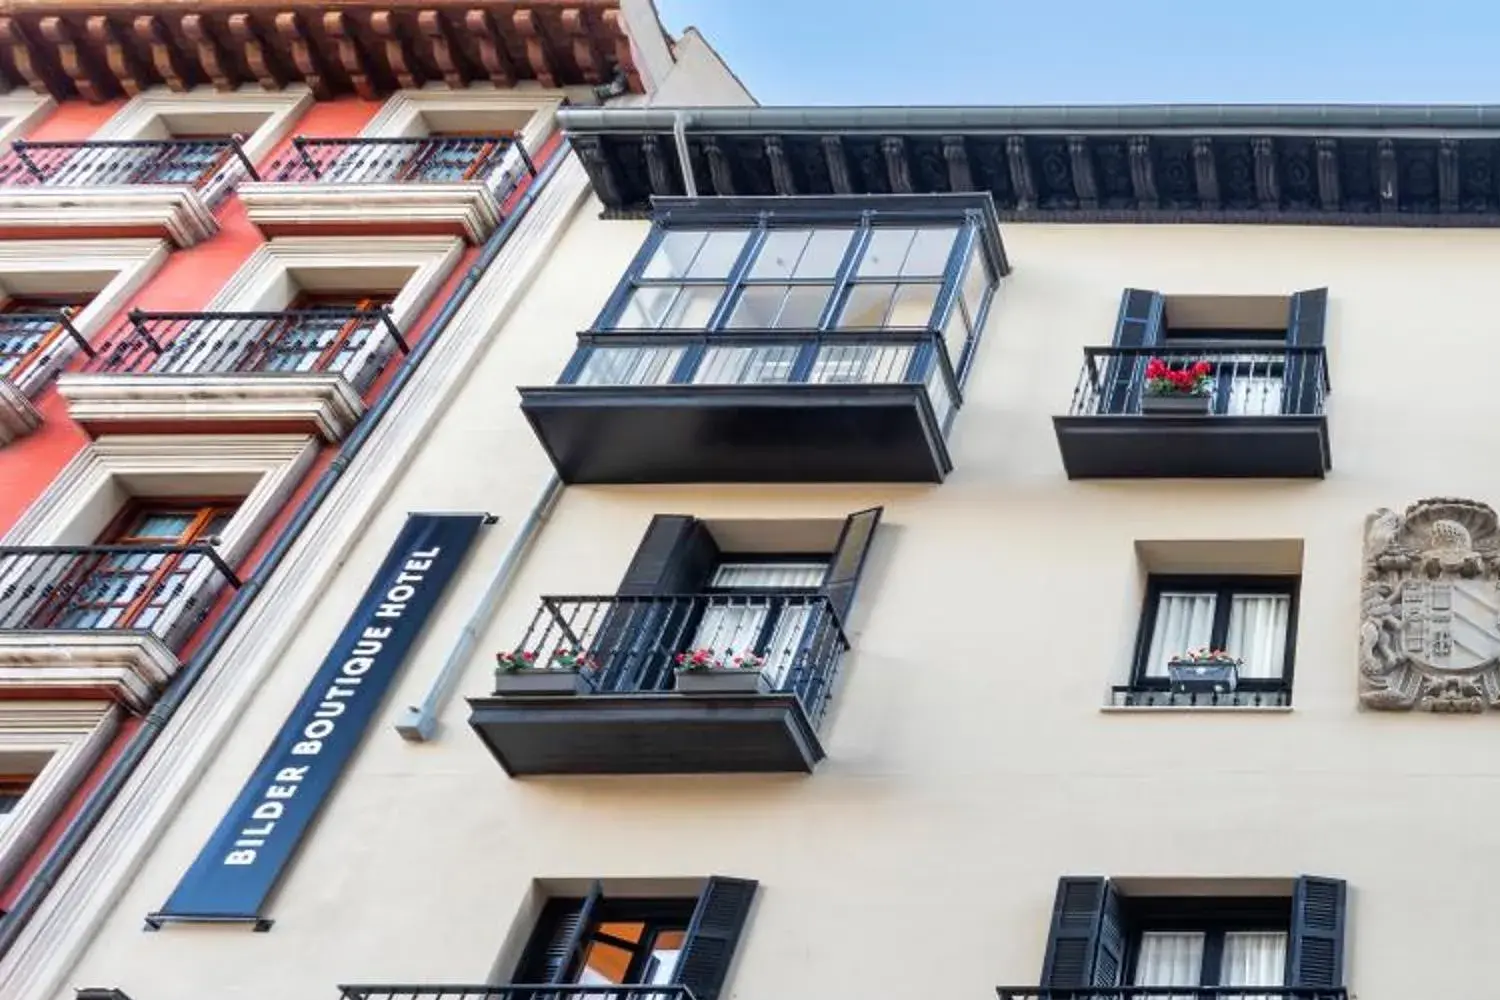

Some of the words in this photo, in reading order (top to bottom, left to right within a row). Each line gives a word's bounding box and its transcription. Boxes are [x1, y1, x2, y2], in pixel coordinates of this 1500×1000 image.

[224, 765, 309, 865] BILDER
[291, 626, 392, 755] BOUTIQUE
[376, 547, 441, 618] HOTEL
